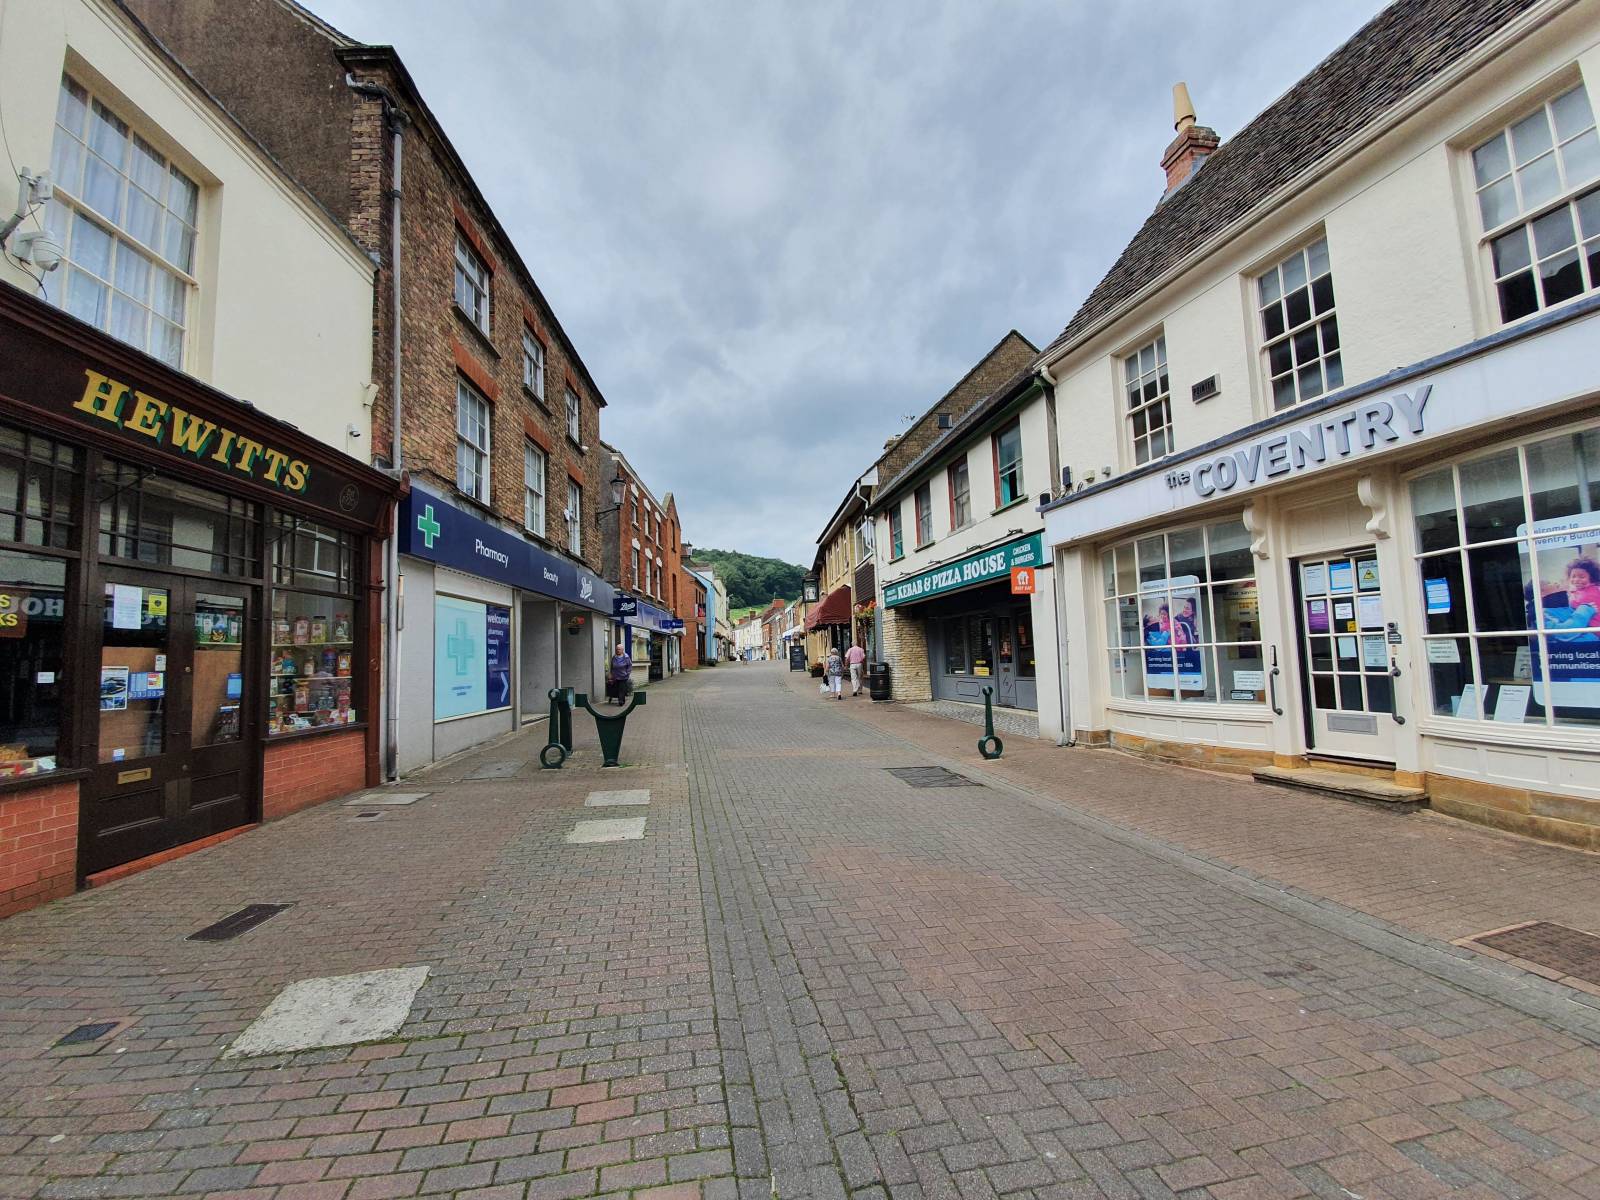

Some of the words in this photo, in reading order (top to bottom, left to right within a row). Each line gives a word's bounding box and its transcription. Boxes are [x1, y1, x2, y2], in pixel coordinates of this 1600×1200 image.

[73, 369, 311, 491] HEWITTS
[1164, 470, 1191, 488] the
[1193, 384, 1433, 497] COVENTRY
[1569, 523, 1579, 531] to
[475, 539, 509, 568] Pharmacy
[543, 567, 559, 586] Beauty
[897, 580, 922, 600] KEBAB
[924, 577, 932, 592] &
[932, 568, 962, 590] PIZZA
[963, 551, 1006, 580] HOUSE
[487, 614, 510, 625] welcome
[1575, 651, 1599, 659] local
[1549, 661, 1600, 670] mmunities
